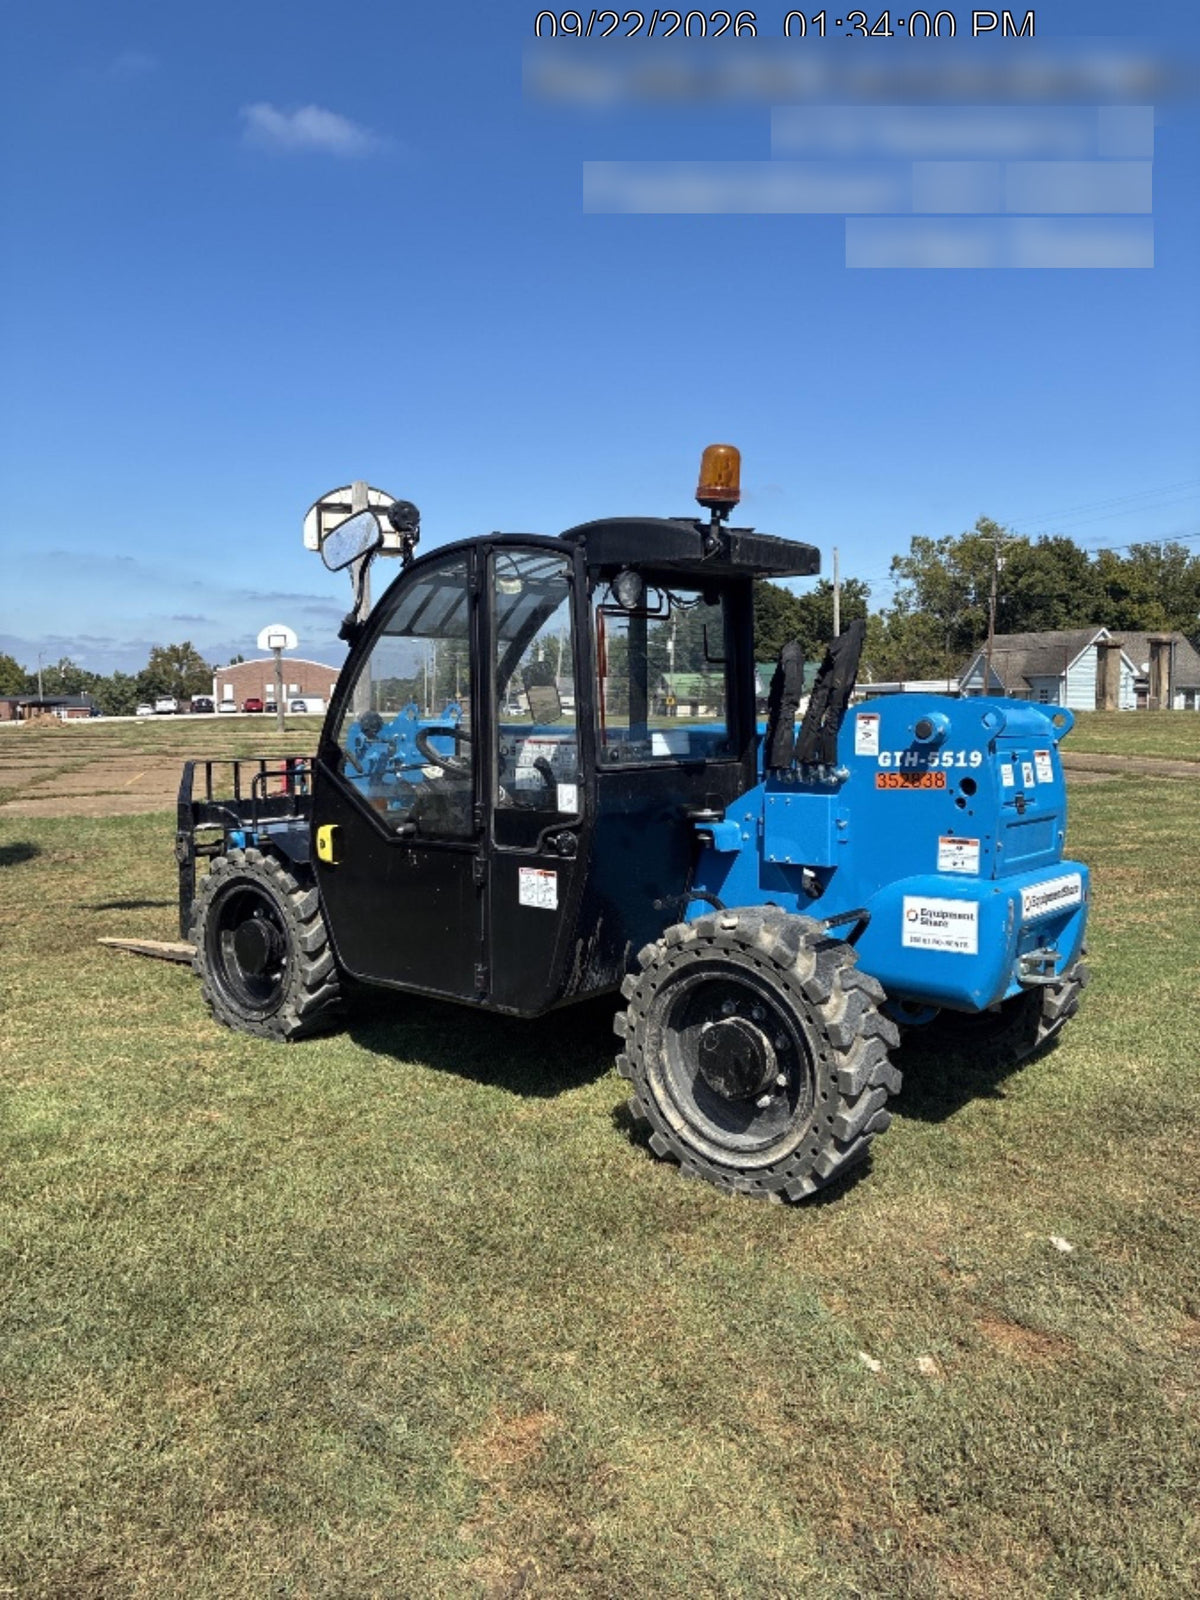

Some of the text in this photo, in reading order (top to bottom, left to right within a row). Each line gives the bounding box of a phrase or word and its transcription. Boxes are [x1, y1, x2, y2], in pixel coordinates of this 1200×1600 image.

[878, 750, 983, 768] GTH-5519
[877, 772, 945, 788] 352838
[920, 907, 975, 921] Equipment
[920, 917, 948, 928] Share
